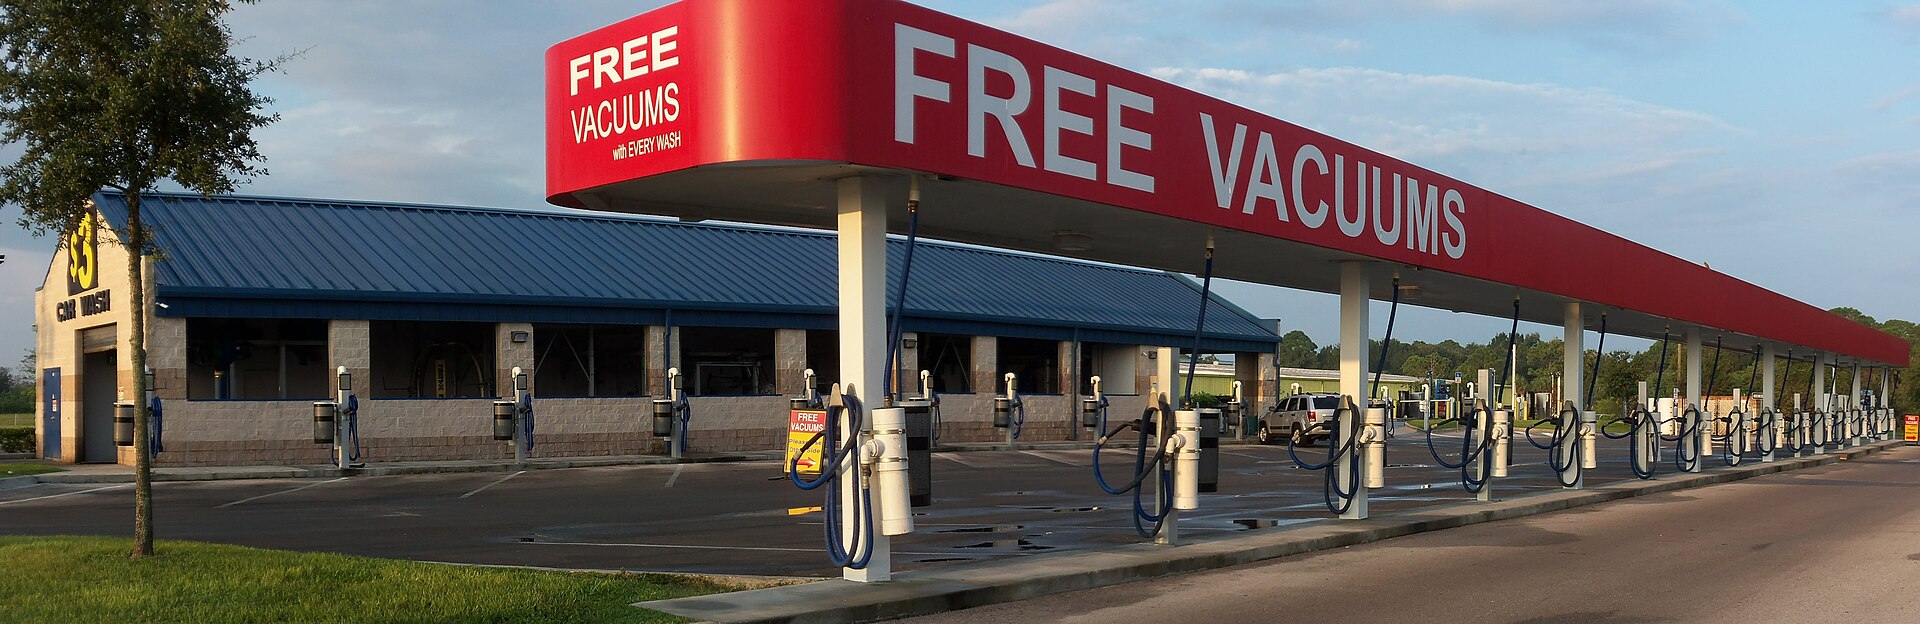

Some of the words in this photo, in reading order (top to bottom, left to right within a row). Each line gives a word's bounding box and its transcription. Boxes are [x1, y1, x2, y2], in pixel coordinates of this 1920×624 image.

[569, 25, 679, 97] FREE
[570, 82, 680, 144] VACUUMS
[613, 143, 627, 161] with
[628, 136, 655, 158] EVERY
[656, 130, 682, 152] WASH
[894, 22, 1155, 194] FREE
[1200, 112, 1466, 260] VACUUMS
[70, 212, 93, 290] $3
[56, 299, 77, 322] CAR
[80, 289, 111, 317] WASH
[790, 422, 824, 432] VACUUMS
[797, 412, 819, 422] FREE
